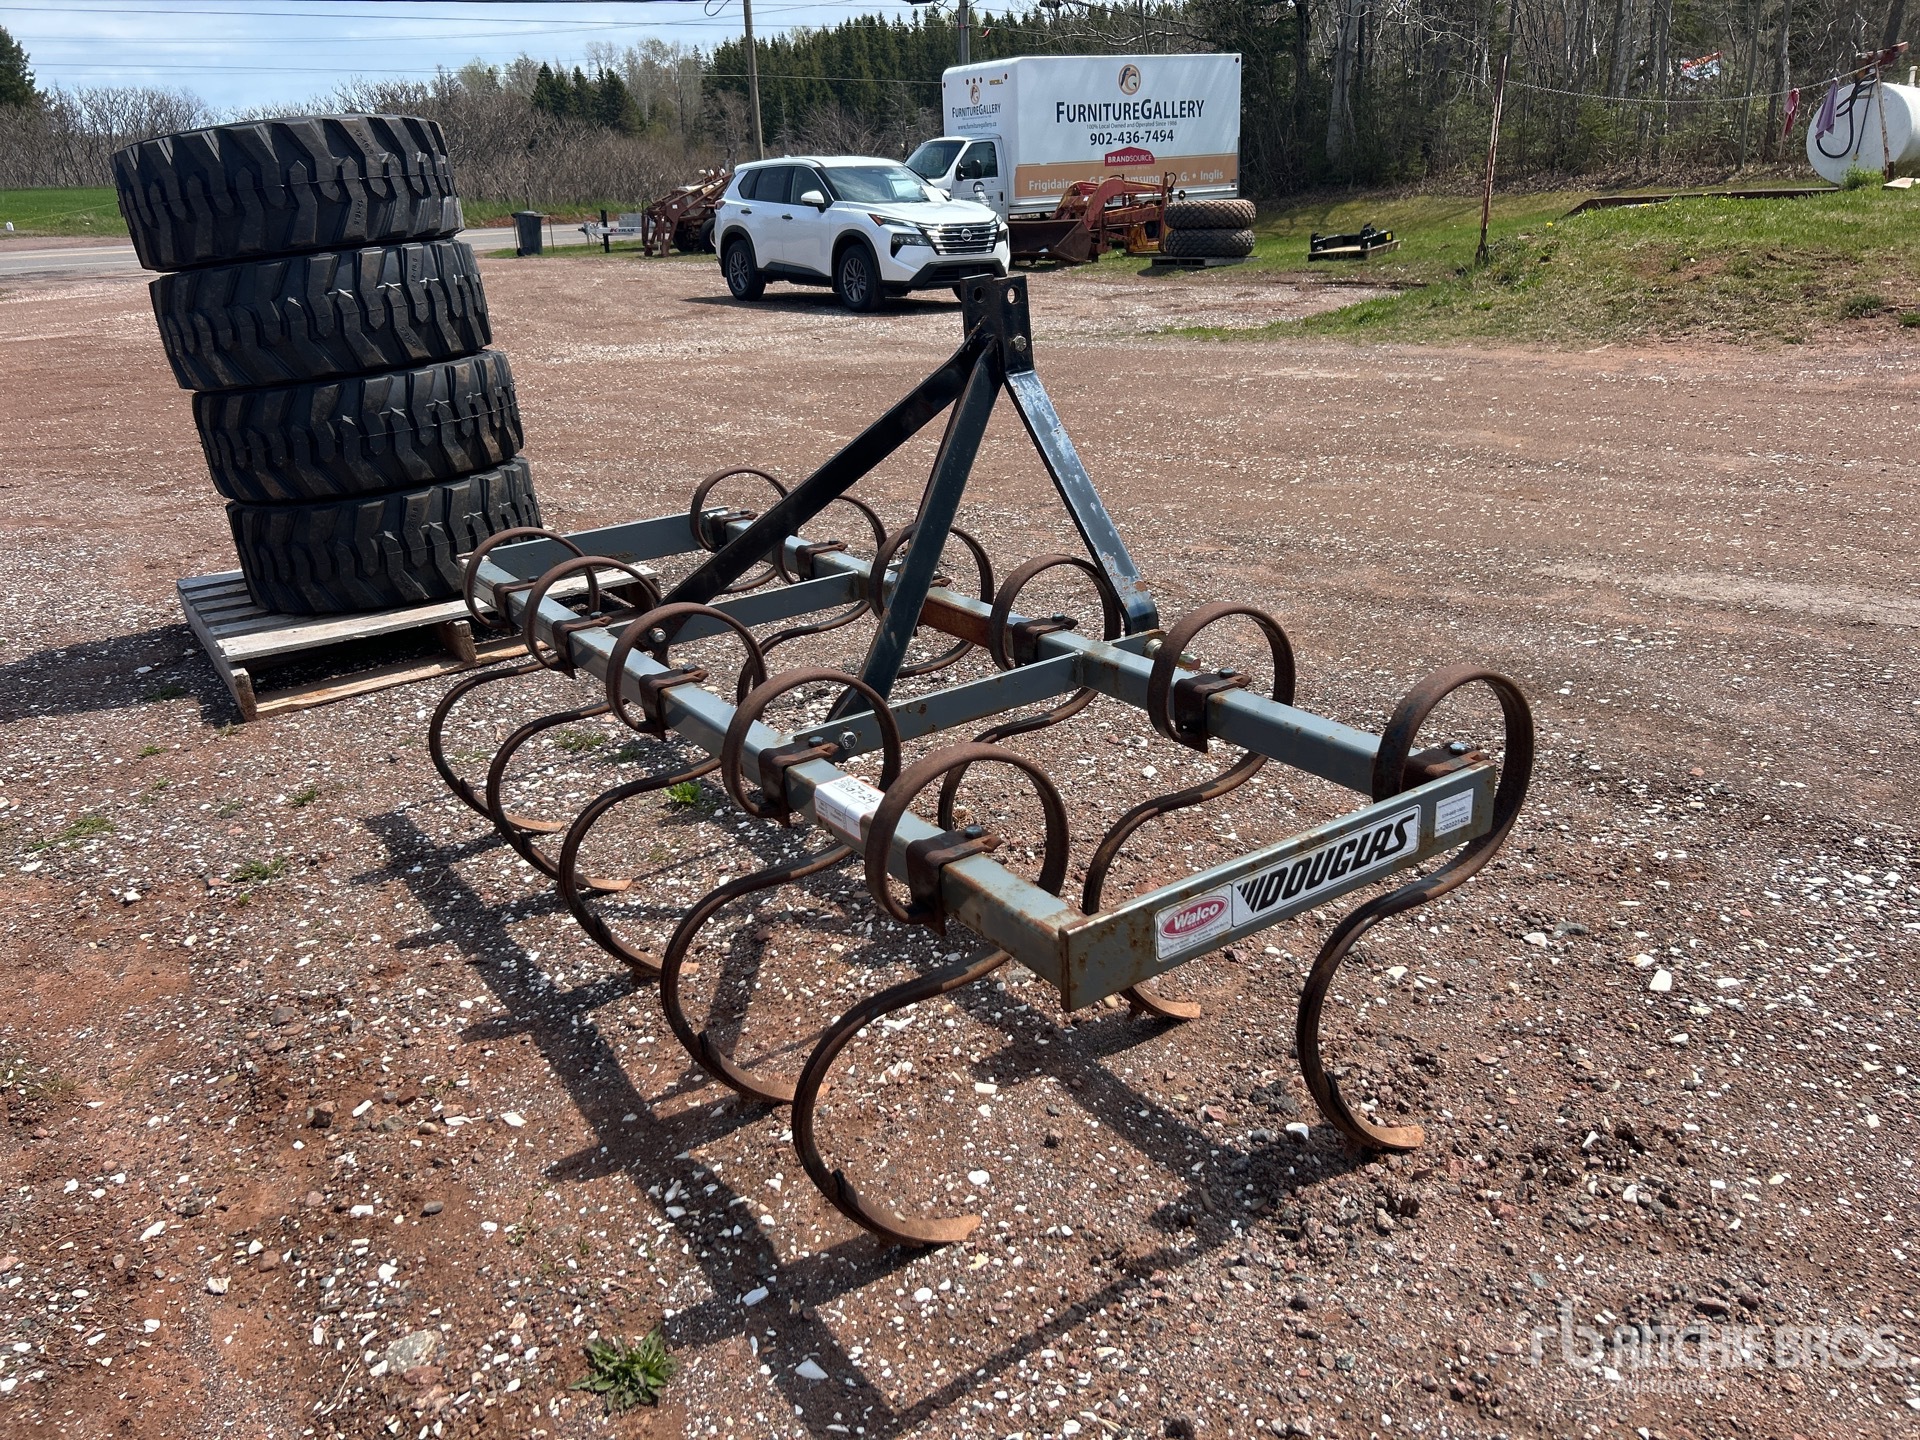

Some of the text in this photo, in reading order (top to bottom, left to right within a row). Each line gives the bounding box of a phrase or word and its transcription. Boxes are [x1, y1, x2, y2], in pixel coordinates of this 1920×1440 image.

[1098, 122, 1111, 130] Local
[1090, 129, 1174, 146] 902-436-7494
[1107, 154, 1152, 164] BRANDSOURCE
[1200, 170, 1224, 181] Inglis
[1256, 813, 1416, 912] DOUGLAS
[1174, 903, 1220, 930] Walco
